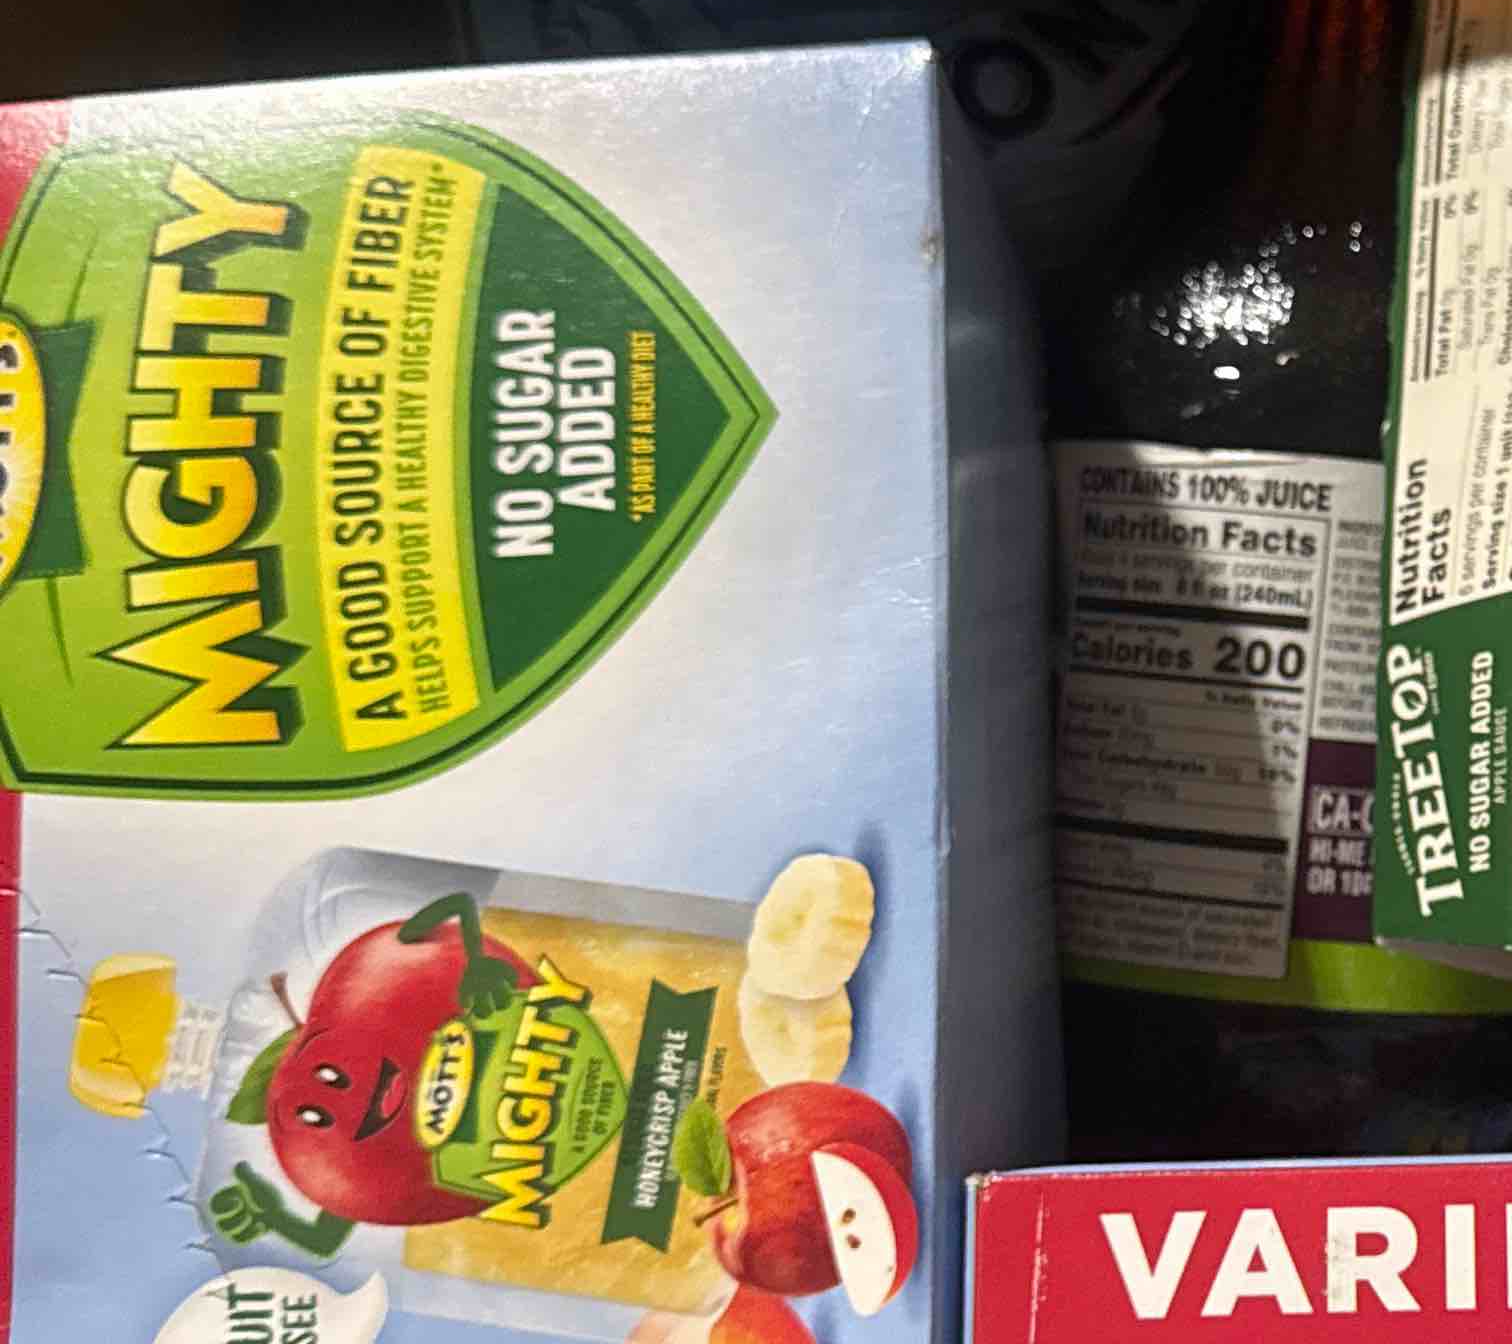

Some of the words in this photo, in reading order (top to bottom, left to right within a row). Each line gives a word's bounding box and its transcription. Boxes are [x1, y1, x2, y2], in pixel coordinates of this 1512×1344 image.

[346, 174, 416, 293] FIBER
[337, 306, 391, 358] OF
[397, 268, 442, 384] DIGESTIVE
[393, 388, 430, 493] HEALTHY
[493, 308, 557, 476] SUGAR
[556, 346, 617, 512] ADDED
[95, 160, 308, 750] MIGHTY
[331, 372, 386, 548] SOURCE
[397, 496, 429, 514] A
[1187, 473, 1250, 505] 100%
[1256, 479, 1333, 512] JUICE
[493, 487, 555, 559] NO
[1083, 511, 1210, 548] Nutrition
[1220, 520, 1318, 557] Facts
[1394, 458, 1429, 615] Nutrition
[1420, 507, 1452, 607] Facts
[337, 559, 399, 683] GOOD
[398, 520, 440, 633] SUPPORT
[354, 690, 408, 720] A
[409, 636, 453, 714] HELPS
[1072, 628, 1195, 670] Calories
[1212, 634, 1306, 680] 200
[1386, 643, 1435, 759] TOP
[1469, 649, 1494, 735] ADDED
[1402, 751, 1465, 918] TREE
[1468, 739, 1492, 830] SUGAR
[1468, 834, 1492, 874] NO
[480, 953, 592, 1230] MIGHTY
[655, 1027, 690, 1088] APPLE
[634, 1089, 677, 1209] HONEYCRISP
